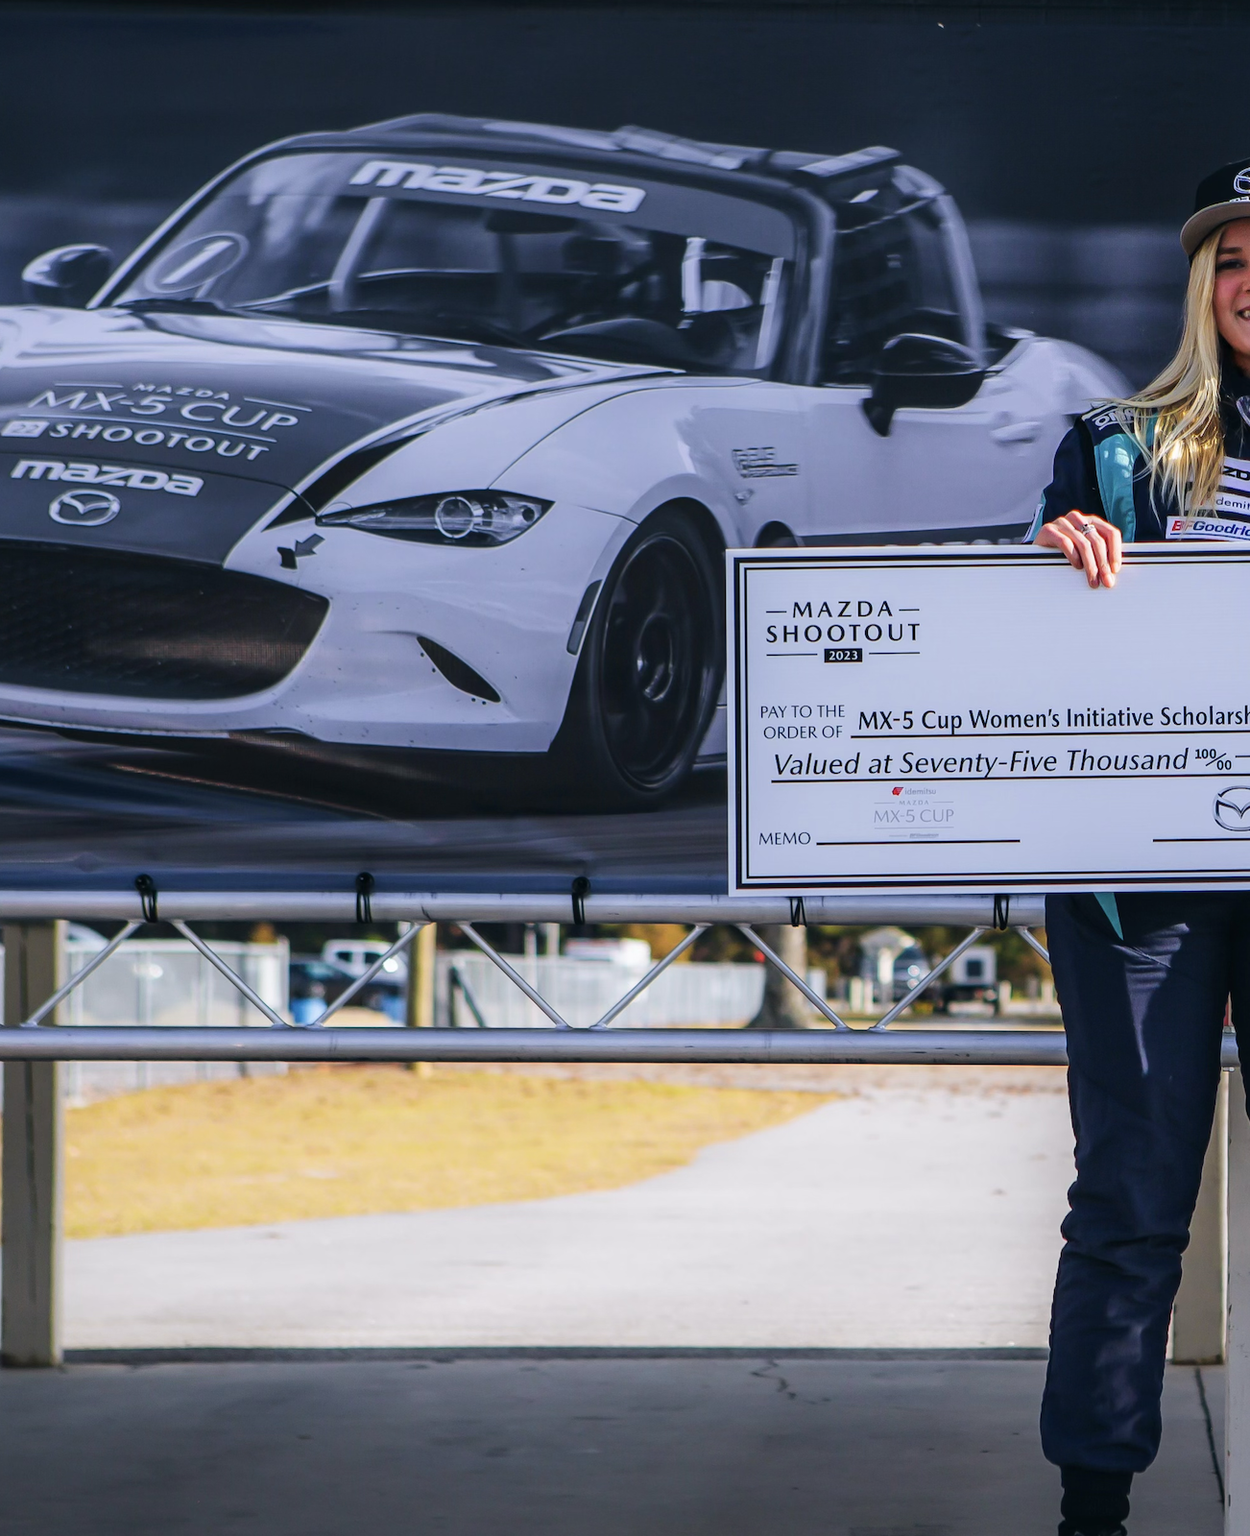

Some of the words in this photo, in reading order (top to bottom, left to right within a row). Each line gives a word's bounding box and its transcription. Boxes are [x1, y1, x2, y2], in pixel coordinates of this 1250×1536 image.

[132, 383, 230, 401] MAZDA
[28, 390, 173, 415] MX-5
[180, 402, 299, 431] CUP
[49, 423, 269, 461] SHOOTOUT
[792, 600, 894, 619] MAZDA
[766, 623, 920, 643] SHOOTOUT
[828, 650, 859, 661] 2023
[760, 705, 787, 719] PAY
[791, 705, 812, 718] TO
[816, 704, 845, 718] THE
[858, 710, 914, 730] MX-5
[921, 710, 962, 735] Cup
[969, 708, 1060, 729] Women's
[1066, 706, 1154, 727] Initiative
[763, 726, 818, 739] ORDER
[822, 725, 843, 739] OF
[774, 752, 860, 776] Valued
[868, 754, 893, 774] at
[899, 750, 1057, 779] Seventy-Five
[1067, 748, 1189, 772] Thousand
[904, 787, 937, 796] idemitsu
[873, 809, 915, 823] MX-5
[919, 808, 955, 823] CUP
[758, 832, 811, 846] MEMO
